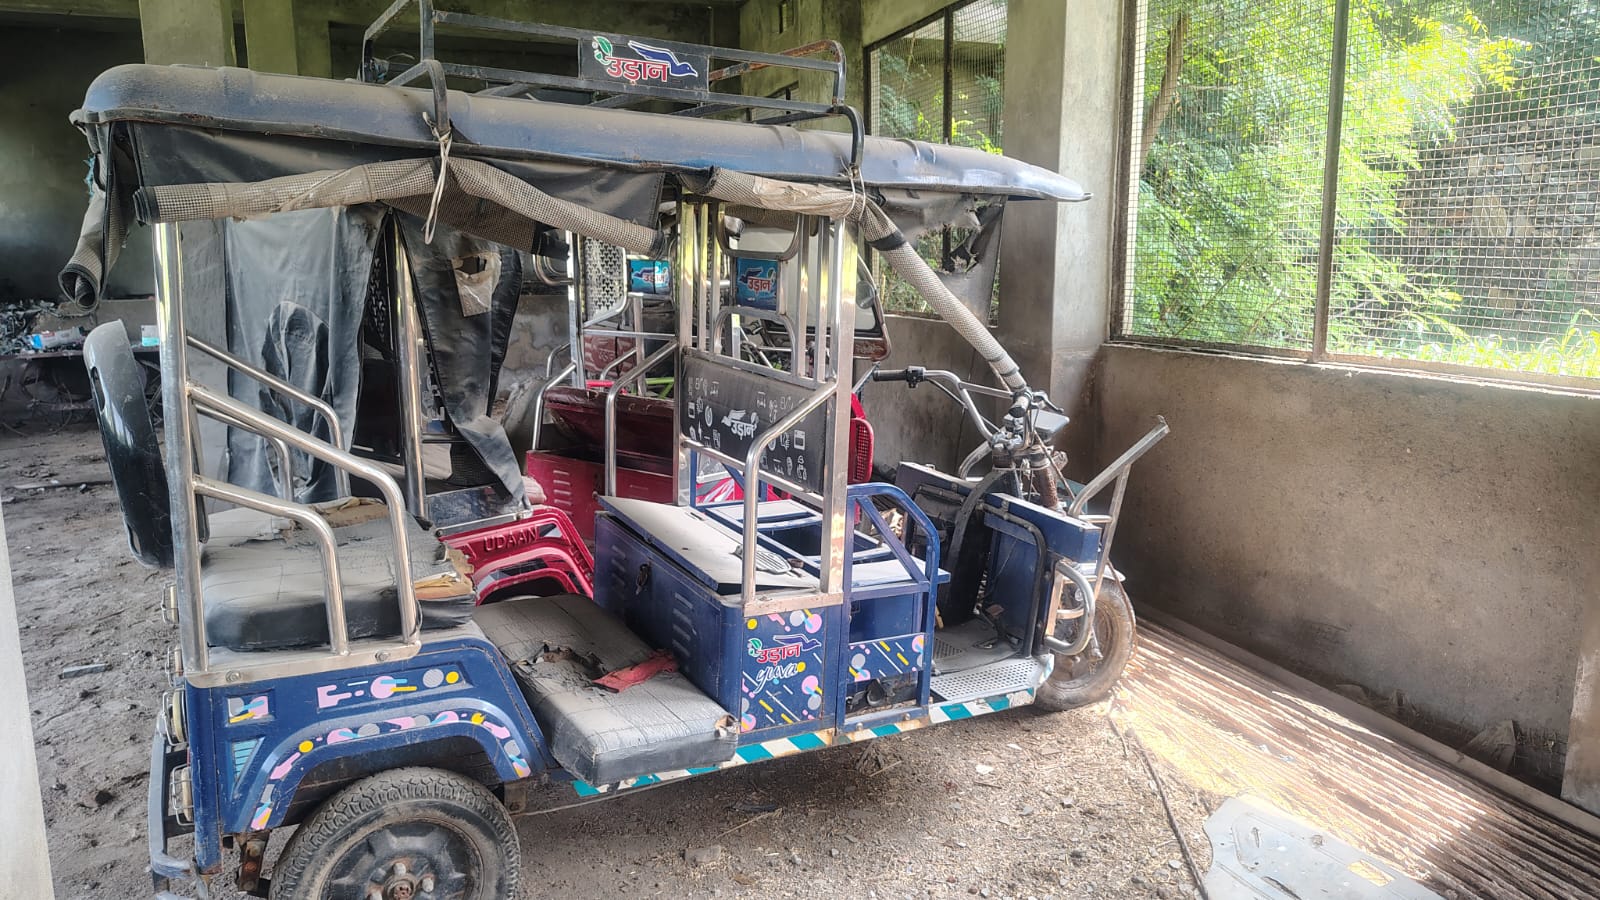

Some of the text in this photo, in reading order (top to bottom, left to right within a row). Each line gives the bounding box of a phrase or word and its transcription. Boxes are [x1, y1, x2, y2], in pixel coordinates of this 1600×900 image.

[605, 56, 669, 85] उड़ान
[747, 276, 771, 296] उड़ान
[731, 419, 757, 440] उड़ान
[484, 525, 538, 551] UDAAN
[757, 644, 802, 666] उड़ान
